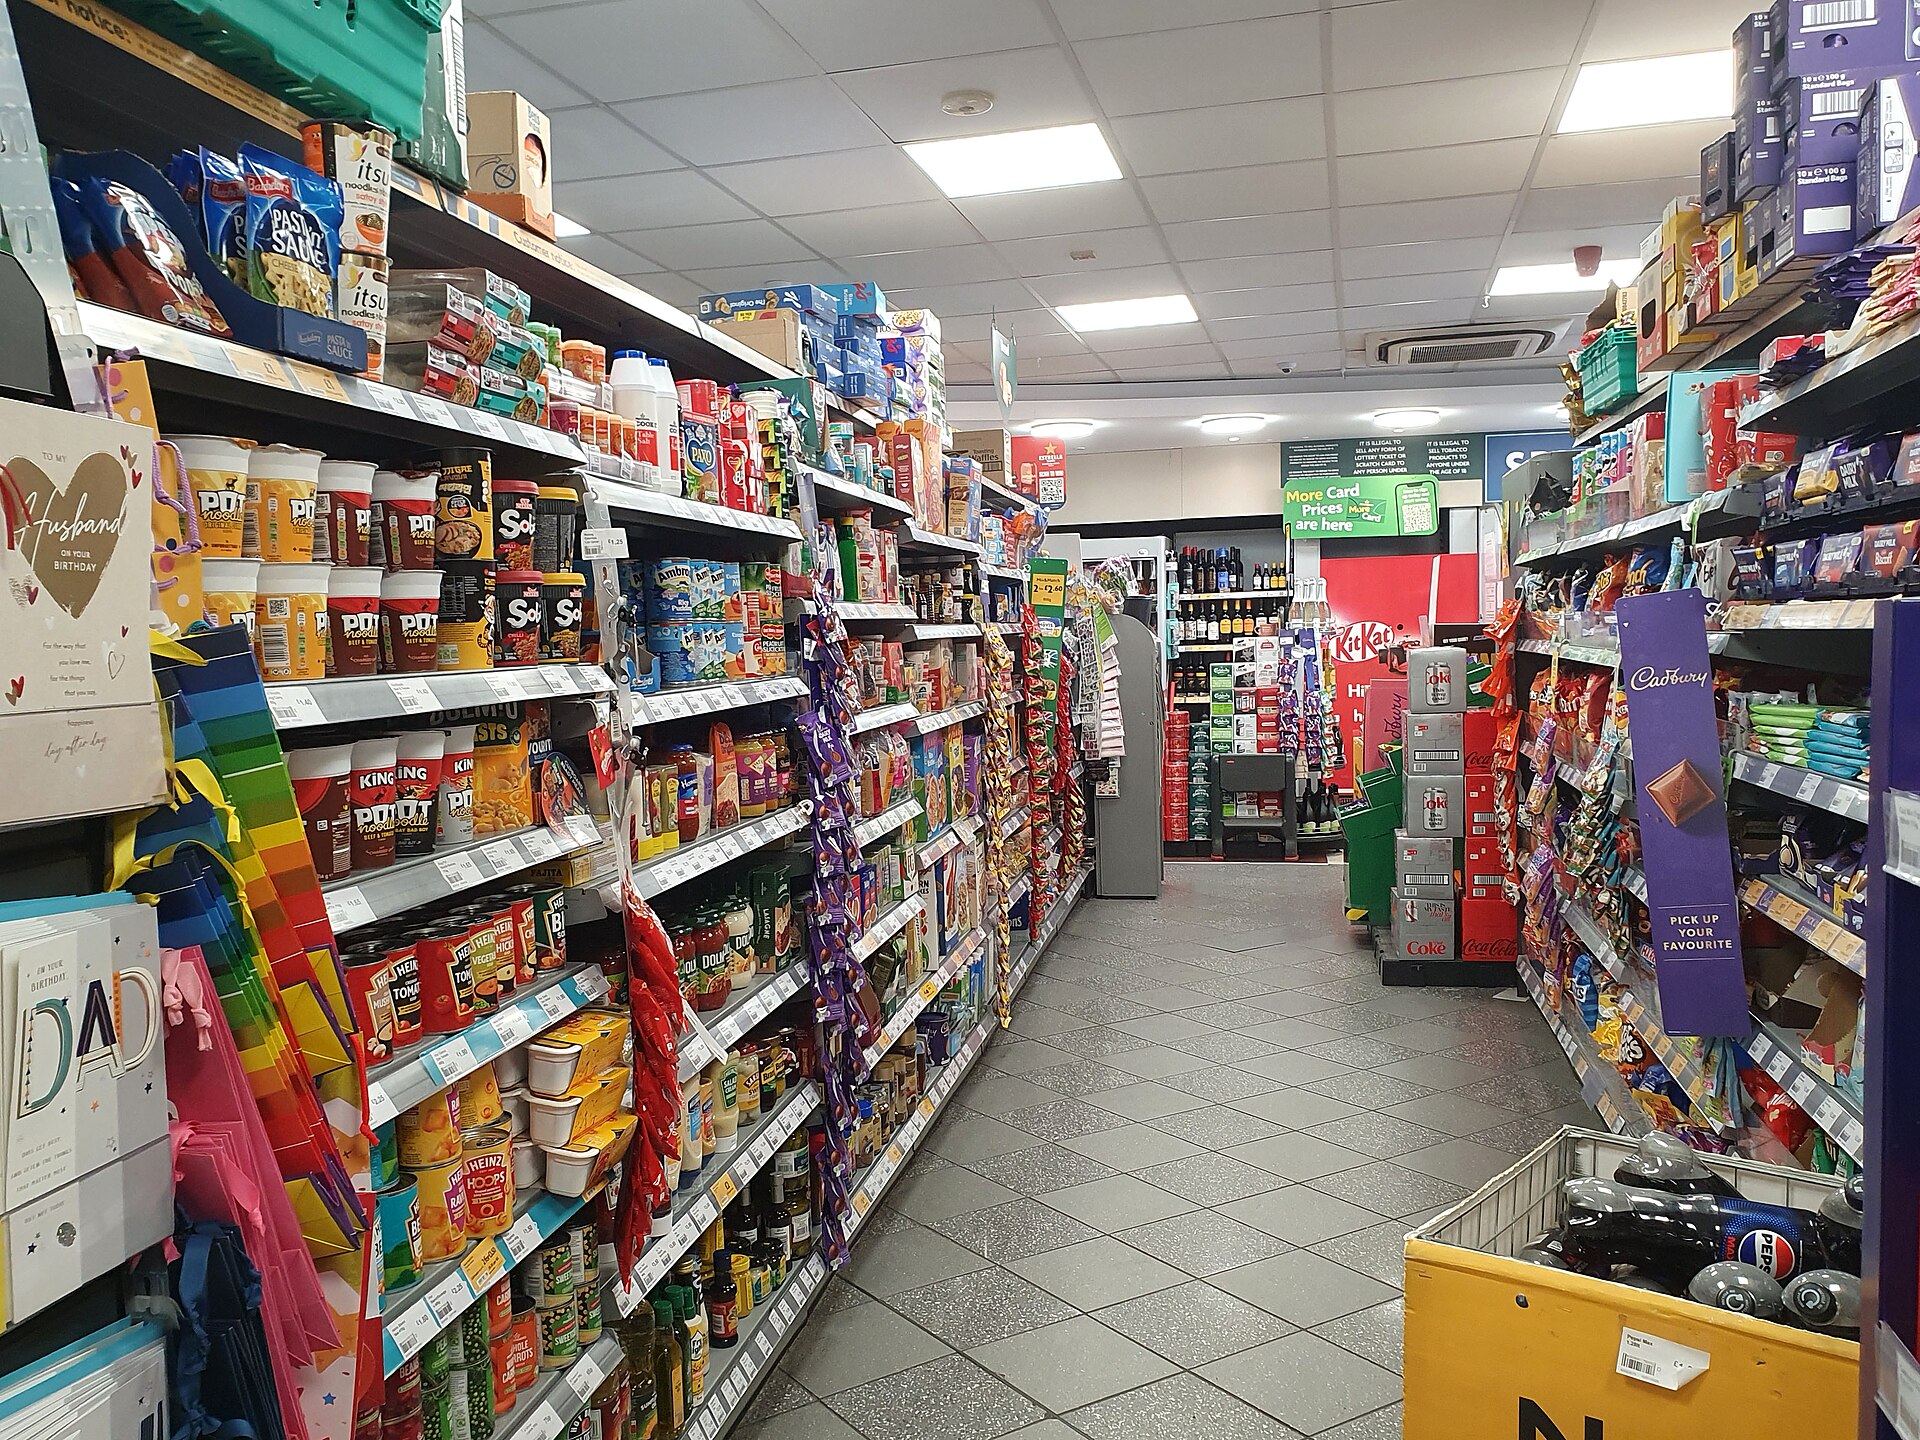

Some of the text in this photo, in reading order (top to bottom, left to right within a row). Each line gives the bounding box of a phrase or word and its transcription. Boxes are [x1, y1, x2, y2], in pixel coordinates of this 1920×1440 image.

[1802, 79, 1855, 91] Standard Bags
[357, 159, 389, 186] itsu
[1797, 174, 1848, 185] Standard Bags
[272, 231, 326, 272] SAUCE
[353, 286, 387, 311] itsu
[326, 334, 346, 347] PASTA
[327, 345, 353, 360] SAUCE
[692, 448, 713, 464] PAXO
[1839, 461, 1857, 476] DAIRY
[1842, 474, 1859, 490] MILK
[1286, 482, 1360, 503] More Card
[202, 509, 243, 522] noodl
[1302, 502, 1343, 517] Prices
[1348, 504, 1370, 514] More
[1296, 514, 1354, 532] are here
[1362, 512, 1381, 522] Card
[14, 487, 129, 571] Husband
[607, 537, 624, 547] £1.25
[60, 549, 91, 558] ON YOUR
[54, 561, 97, 572] BIRTHDAY
[1033, 584, 1040, 592] 2
[400, 613, 439, 633] POT
[344, 626, 379, 639] noodl
[402, 626, 438, 639] noodl
[1334, 623, 1394, 661] KitKat
[1630, 666, 1708, 691] Cadbury
[357, 818, 395, 834] noodl
[395, 814, 430, 828] oodle
[1670, 913, 1720, 928] PICK UP
[1679, 927, 1714, 938] YOUR
[1407, 941, 1446, 955] Coke
[1663, 939, 1733, 951] FAVOURITE
[16, 966, 161, 1120] DAD
[469, 1155, 503, 1172] HEINZ
[467, 1171, 506, 1190] HOOPS
[1759, 1233, 1774, 1275] PEPS
